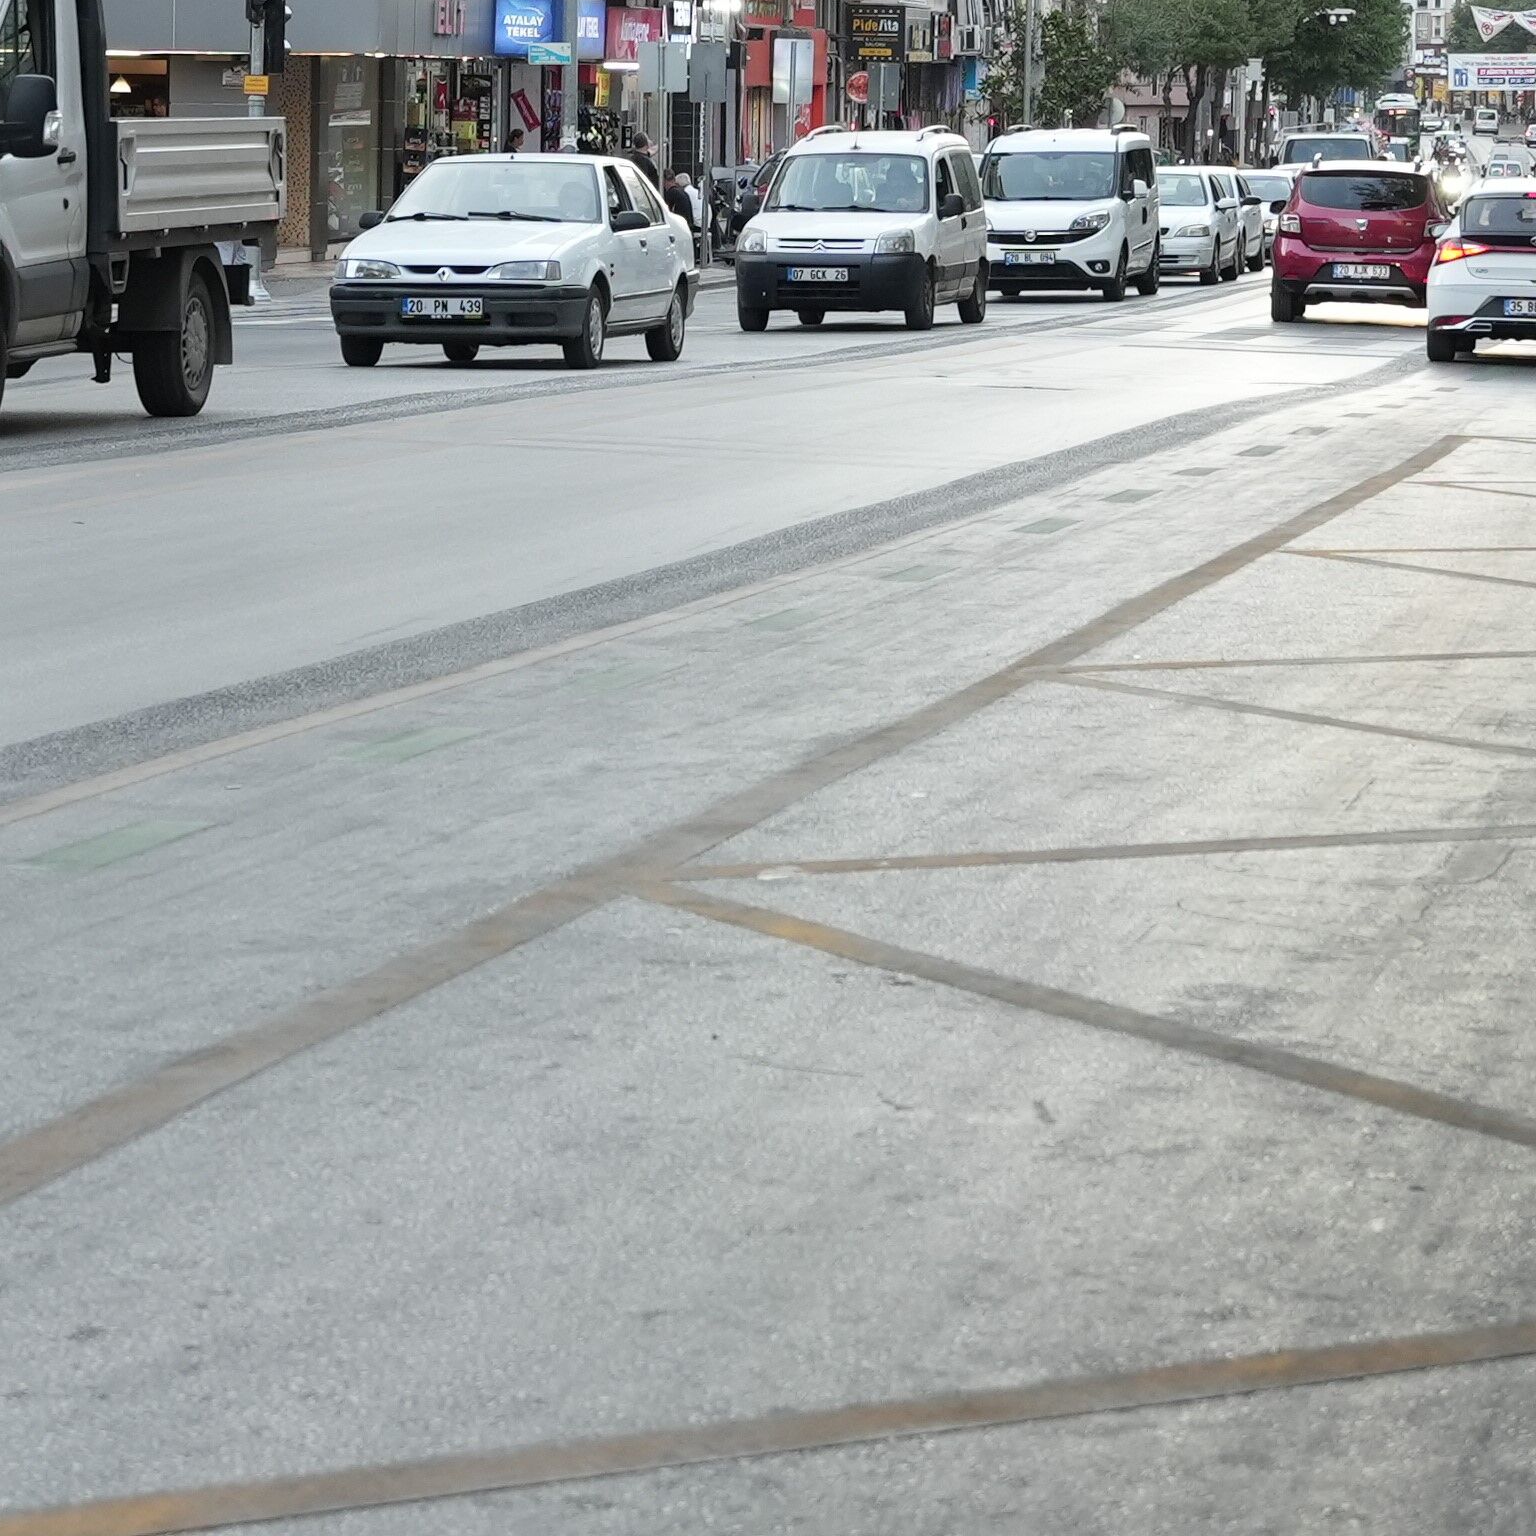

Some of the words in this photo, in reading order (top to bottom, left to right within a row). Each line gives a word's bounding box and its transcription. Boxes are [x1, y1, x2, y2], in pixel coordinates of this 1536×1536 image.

[503, 15, 544, 27] ATALAY
[506, 26, 541, 39] TEKEL
[792, 269, 804, 279] 07
[810, 269, 827, 280] GCK
[835, 269, 847, 280] 26
[408, 299, 423, 313] 20
[433, 299, 448, 313] PN
[459, 299, 481, 313] 439
[1510, 301, 1523, 312] 35
